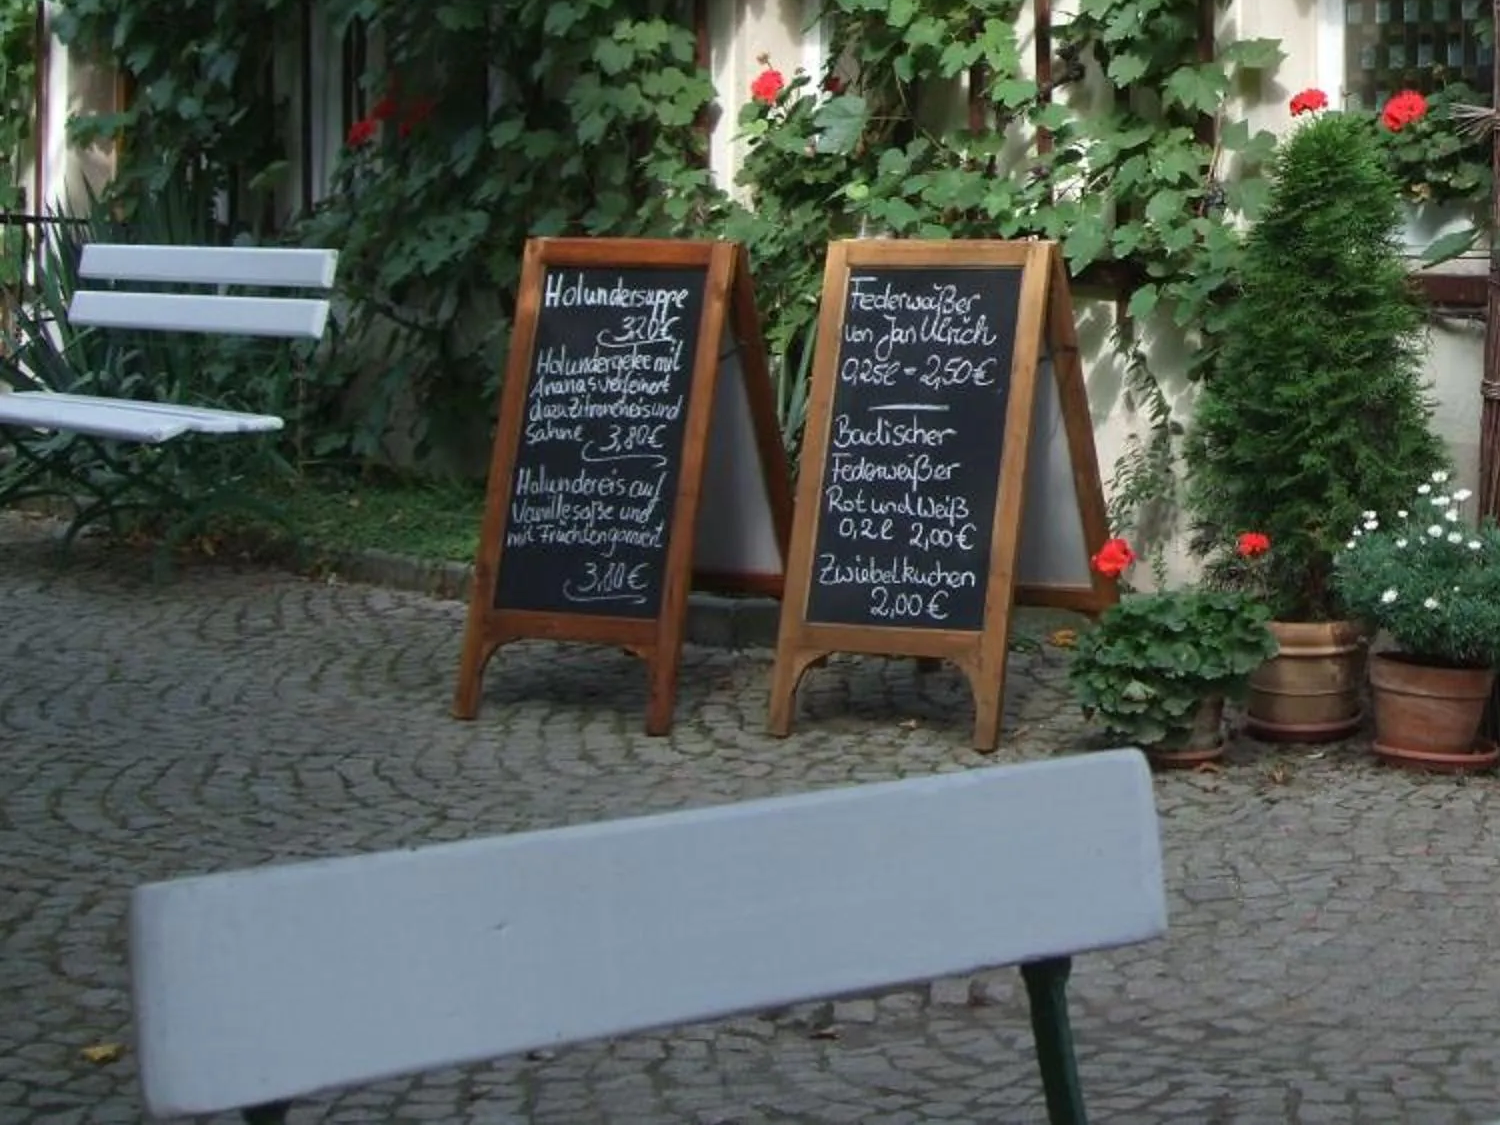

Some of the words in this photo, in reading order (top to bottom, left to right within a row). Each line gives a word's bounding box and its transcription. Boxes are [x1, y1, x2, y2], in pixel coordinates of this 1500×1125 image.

[545, 272, 689, 322] Holundersuppe
[845, 324, 873, 344] von
[874, 314, 917, 362] Jan
[536, 343, 651, 378] Holundergelee
[653, 340, 684, 372] mit
[530, 375, 597, 397] Ananas
[529, 396, 568, 421] dazu
[651, 394, 684, 420] und
[525, 419, 584, 445] Sahne
[832, 413, 958, 448] Badischer
[515, 466, 626, 496] Holundereis
[628, 470, 670, 501] auf
[831, 453, 962, 492] Federweißer
[619, 496, 661, 524] und
[826, 485, 867, 513] Rot
[871, 493, 915, 516] und
[915, 495, 969, 527] Weiß
[507, 524, 537, 548] mit
[818, 554, 976, 588] Zwiebelkuchen
